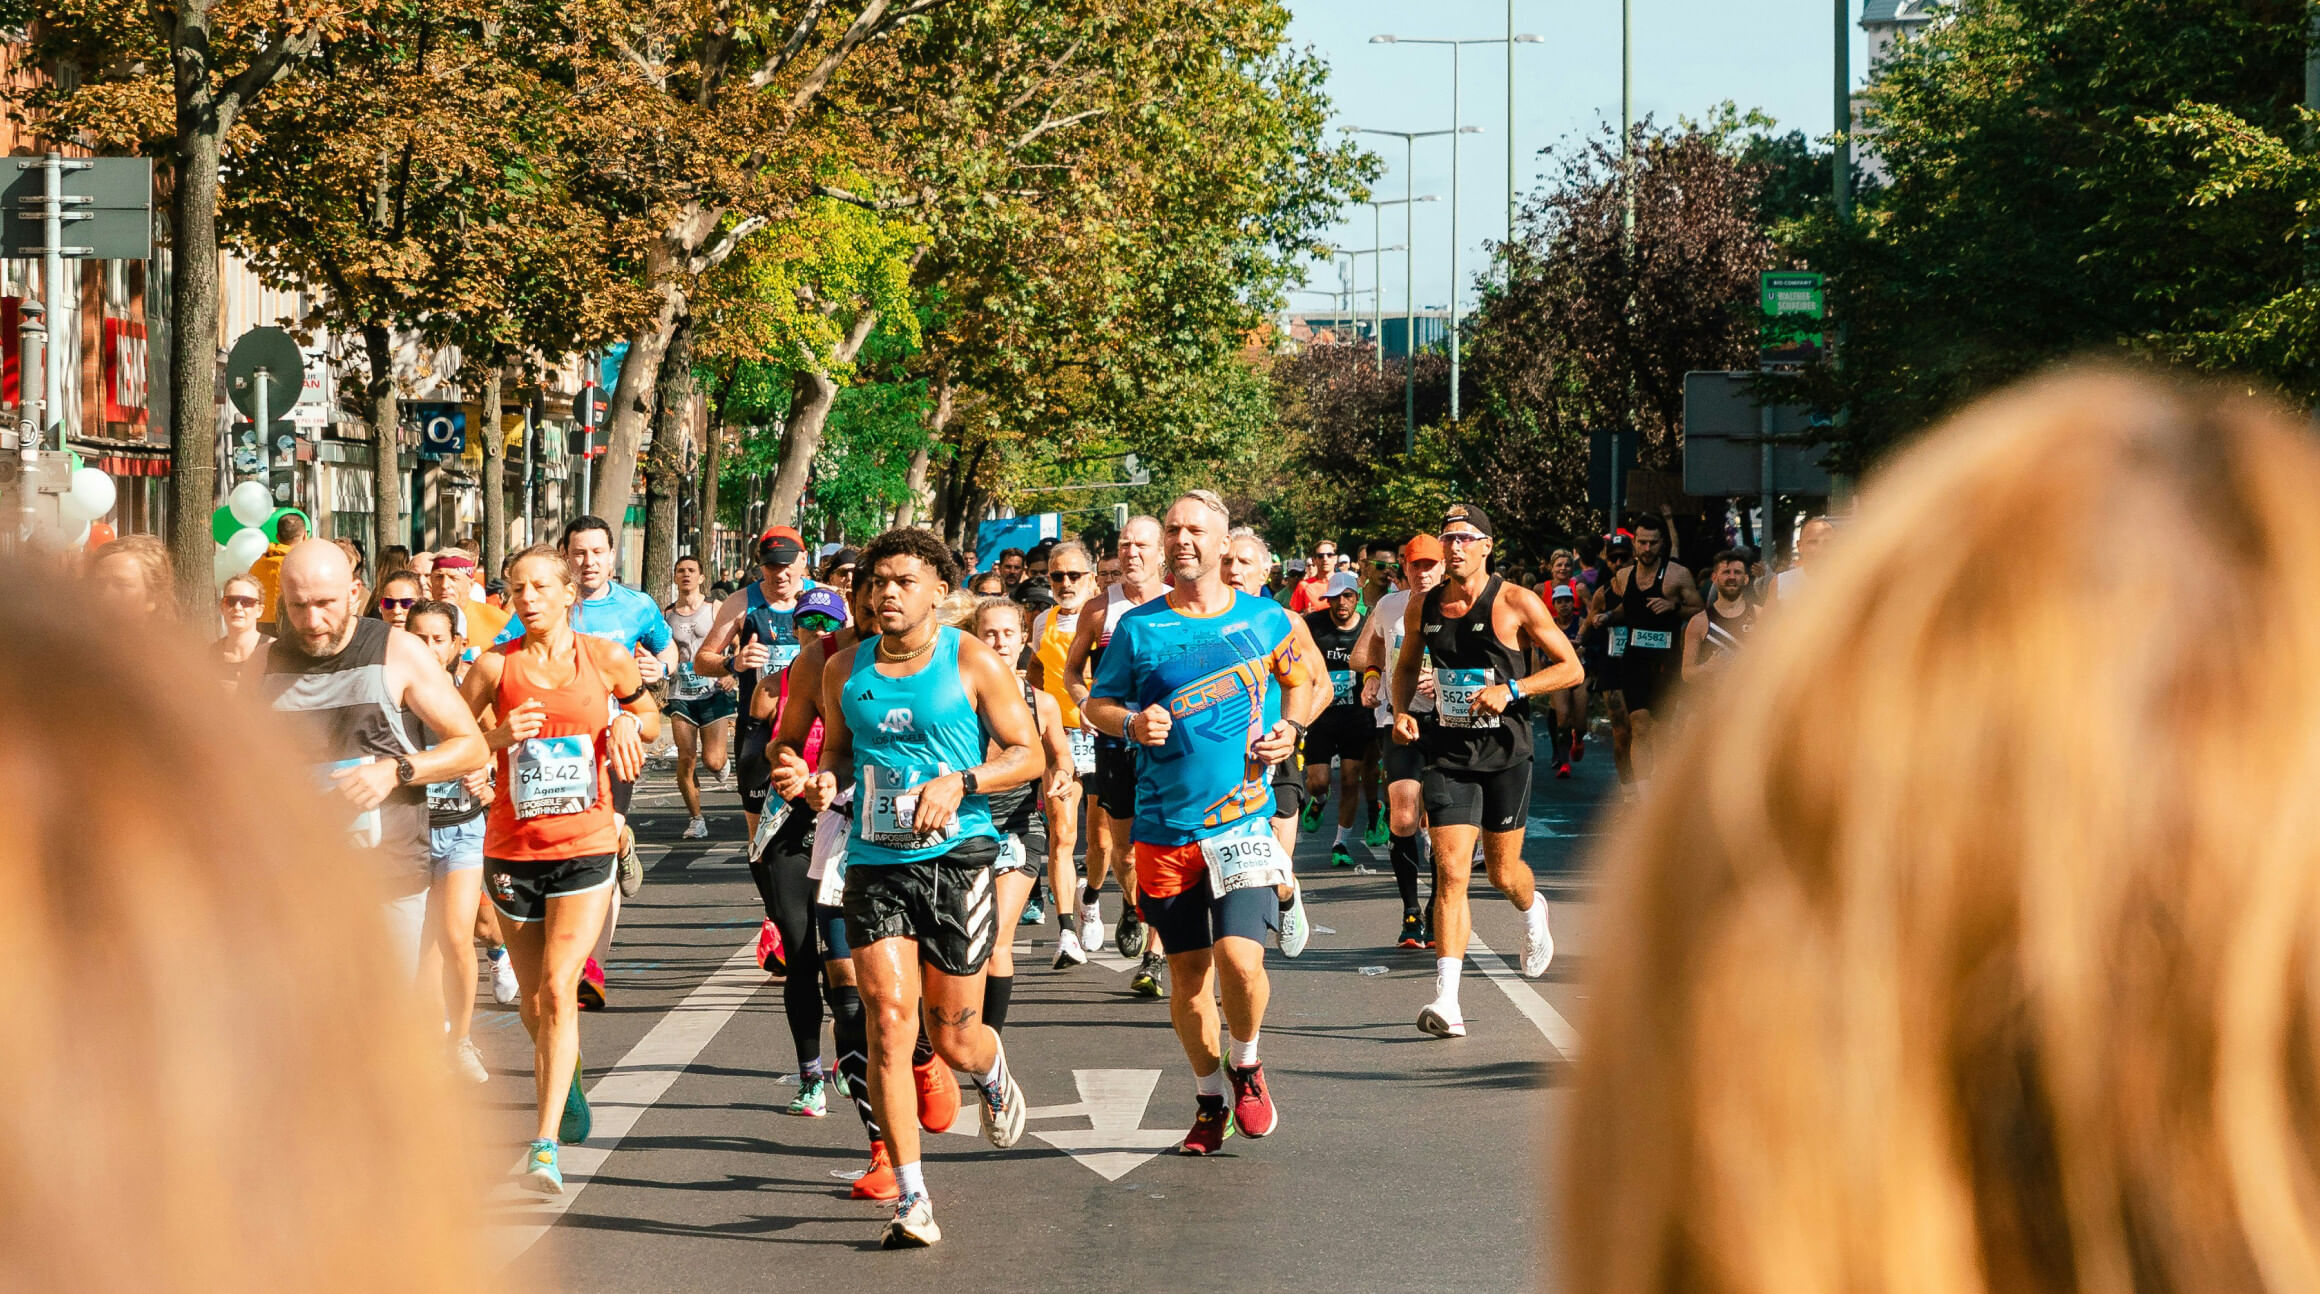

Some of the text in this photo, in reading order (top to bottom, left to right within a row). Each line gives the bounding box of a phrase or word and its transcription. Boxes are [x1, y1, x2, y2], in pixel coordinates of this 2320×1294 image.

[1636, 631, 1665, 641] 34582
[1442, 690, 1474, 704] 5628
[1452, 707, 1469, 715] Pasc
[521, 765, 580, 785] 64542
[534, 786, 566, 796] Agnes
[749, 789, 767, 799] ALAN
[875, 833, 922, 842] IMPOSSIBLE
[1219, 841, 1272, 863] 31063
[1235, 860, 1269, 870] Tobias
